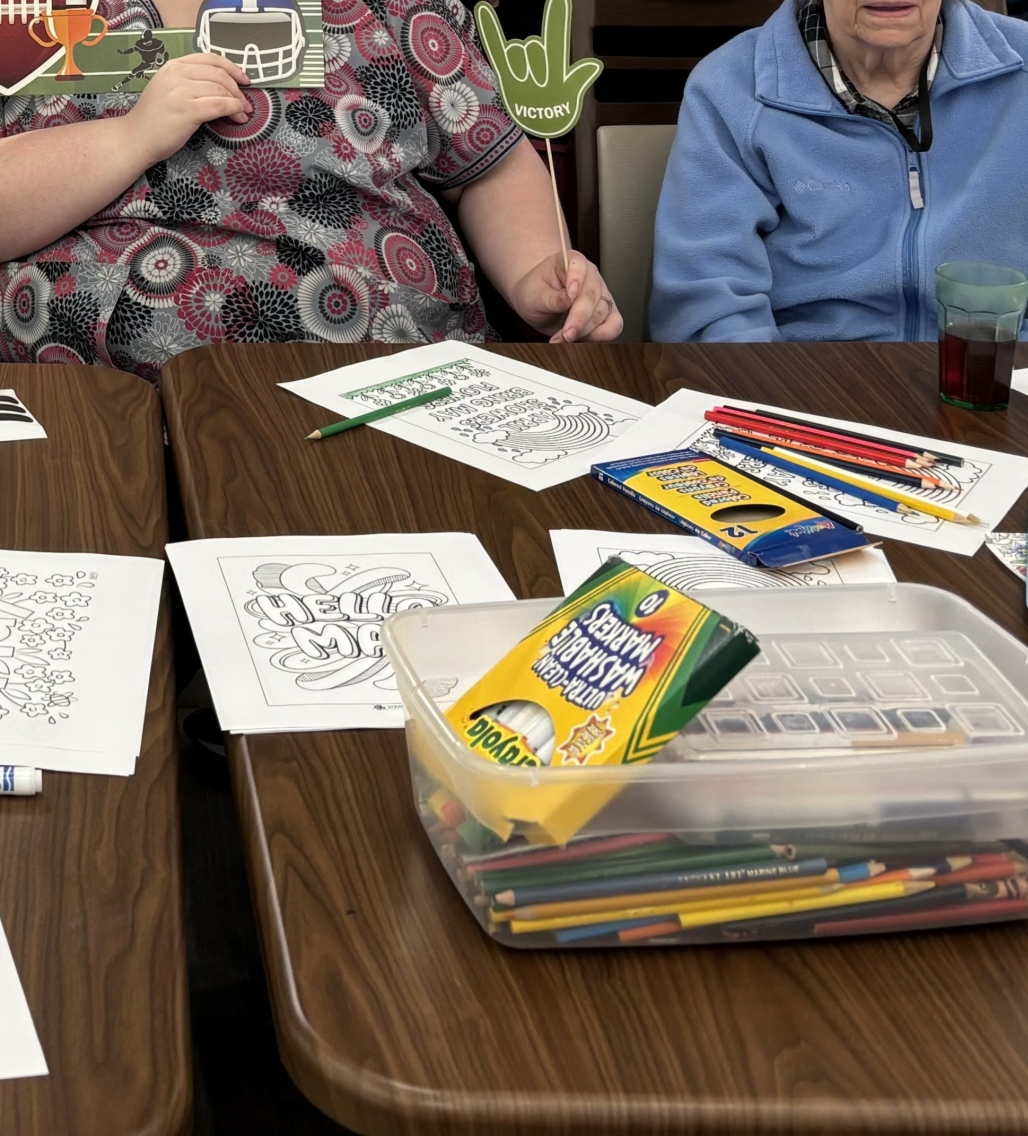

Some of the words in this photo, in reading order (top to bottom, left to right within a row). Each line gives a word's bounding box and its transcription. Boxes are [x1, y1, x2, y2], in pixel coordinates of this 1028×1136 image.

[514, 100, 571, 122] VICTORY
[469, 386, 534, 408] BRING
[428, 405, 470, 422] MAY
[460, 399, 548, 428] SHOWERS
[498, 412, 557, 433] APRIL
[719, 524, 758, 538] 12
[640, 593, 662, 611] 10
[291, 623, 384, 660] MA
[591, 602, 664, 663] MARKERS
[548, 620, 645, 697] WASHABLE
[532, 653, 606, 710] ULTRA-CLEAN
